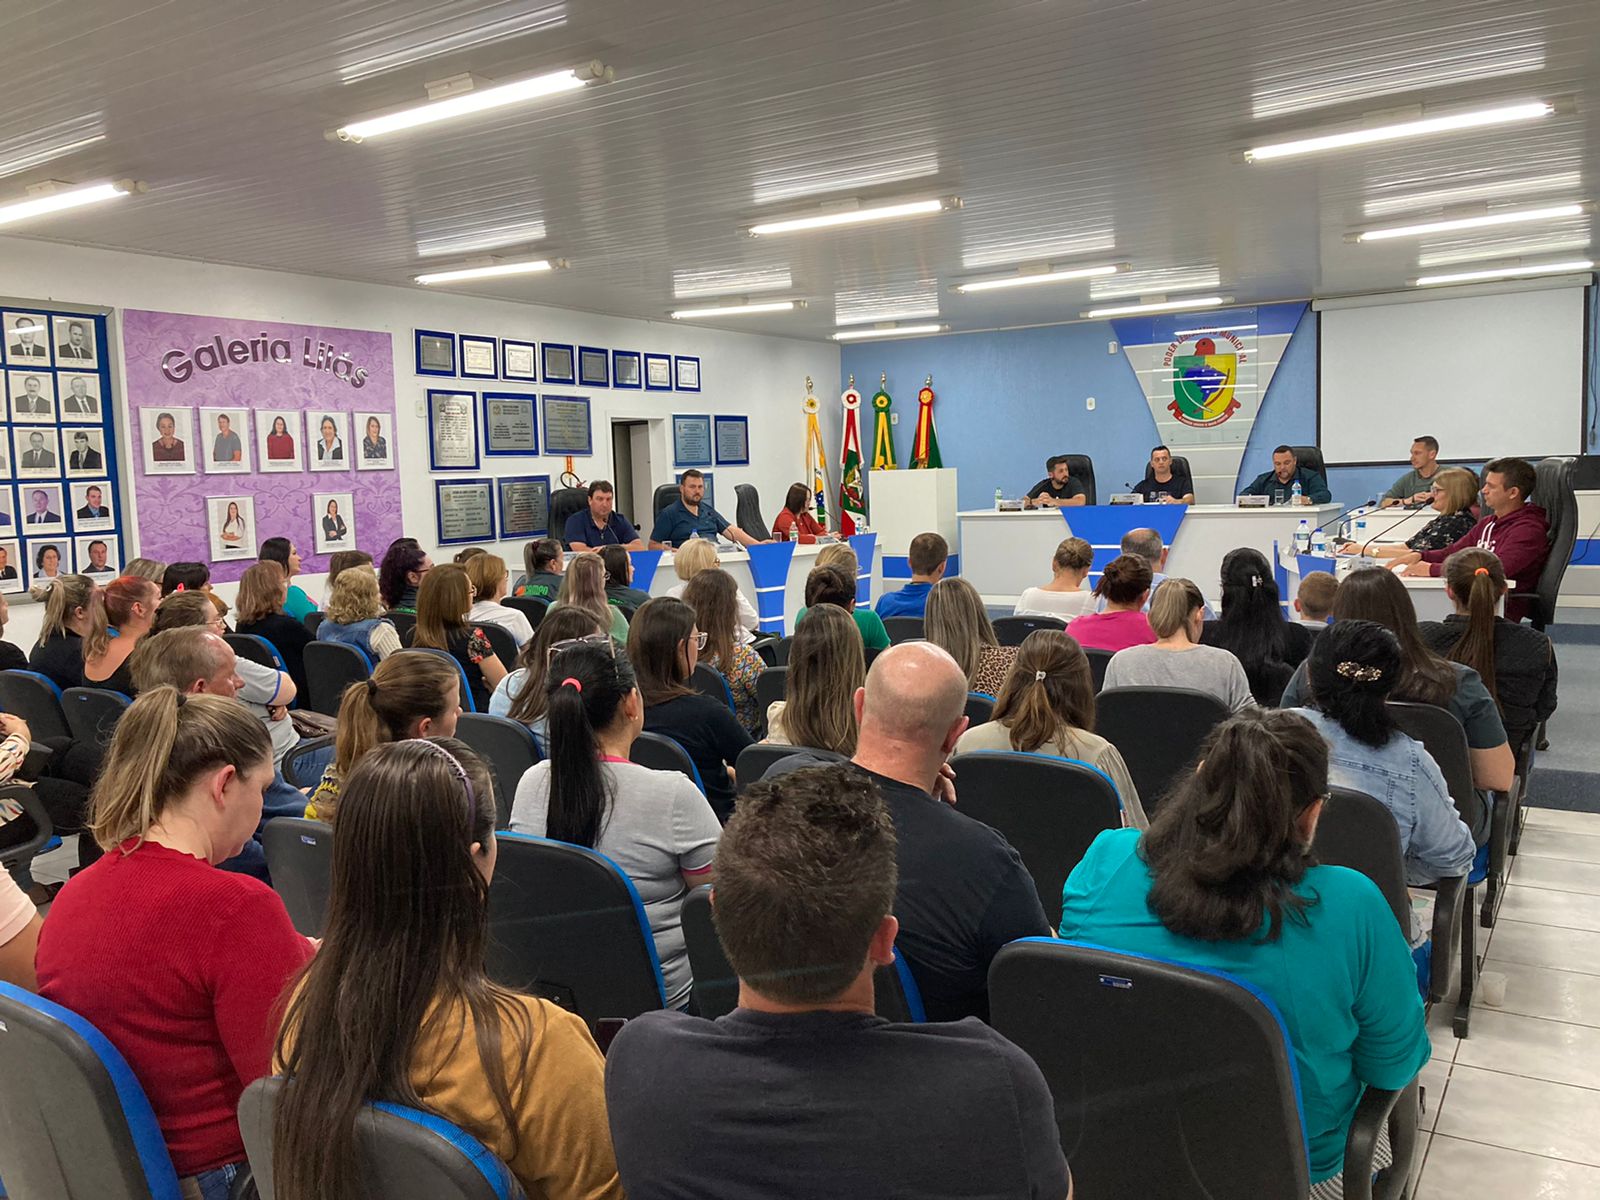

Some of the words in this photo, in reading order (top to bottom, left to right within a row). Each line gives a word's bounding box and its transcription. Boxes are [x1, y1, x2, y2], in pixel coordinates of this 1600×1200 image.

[161, 332, 292, 383] Galeria
[303, 336, 369, 389] Lilás
[1163, 342, 1178, 367] PODER
[1218, 330, 1247, 364] MUNICIAL
